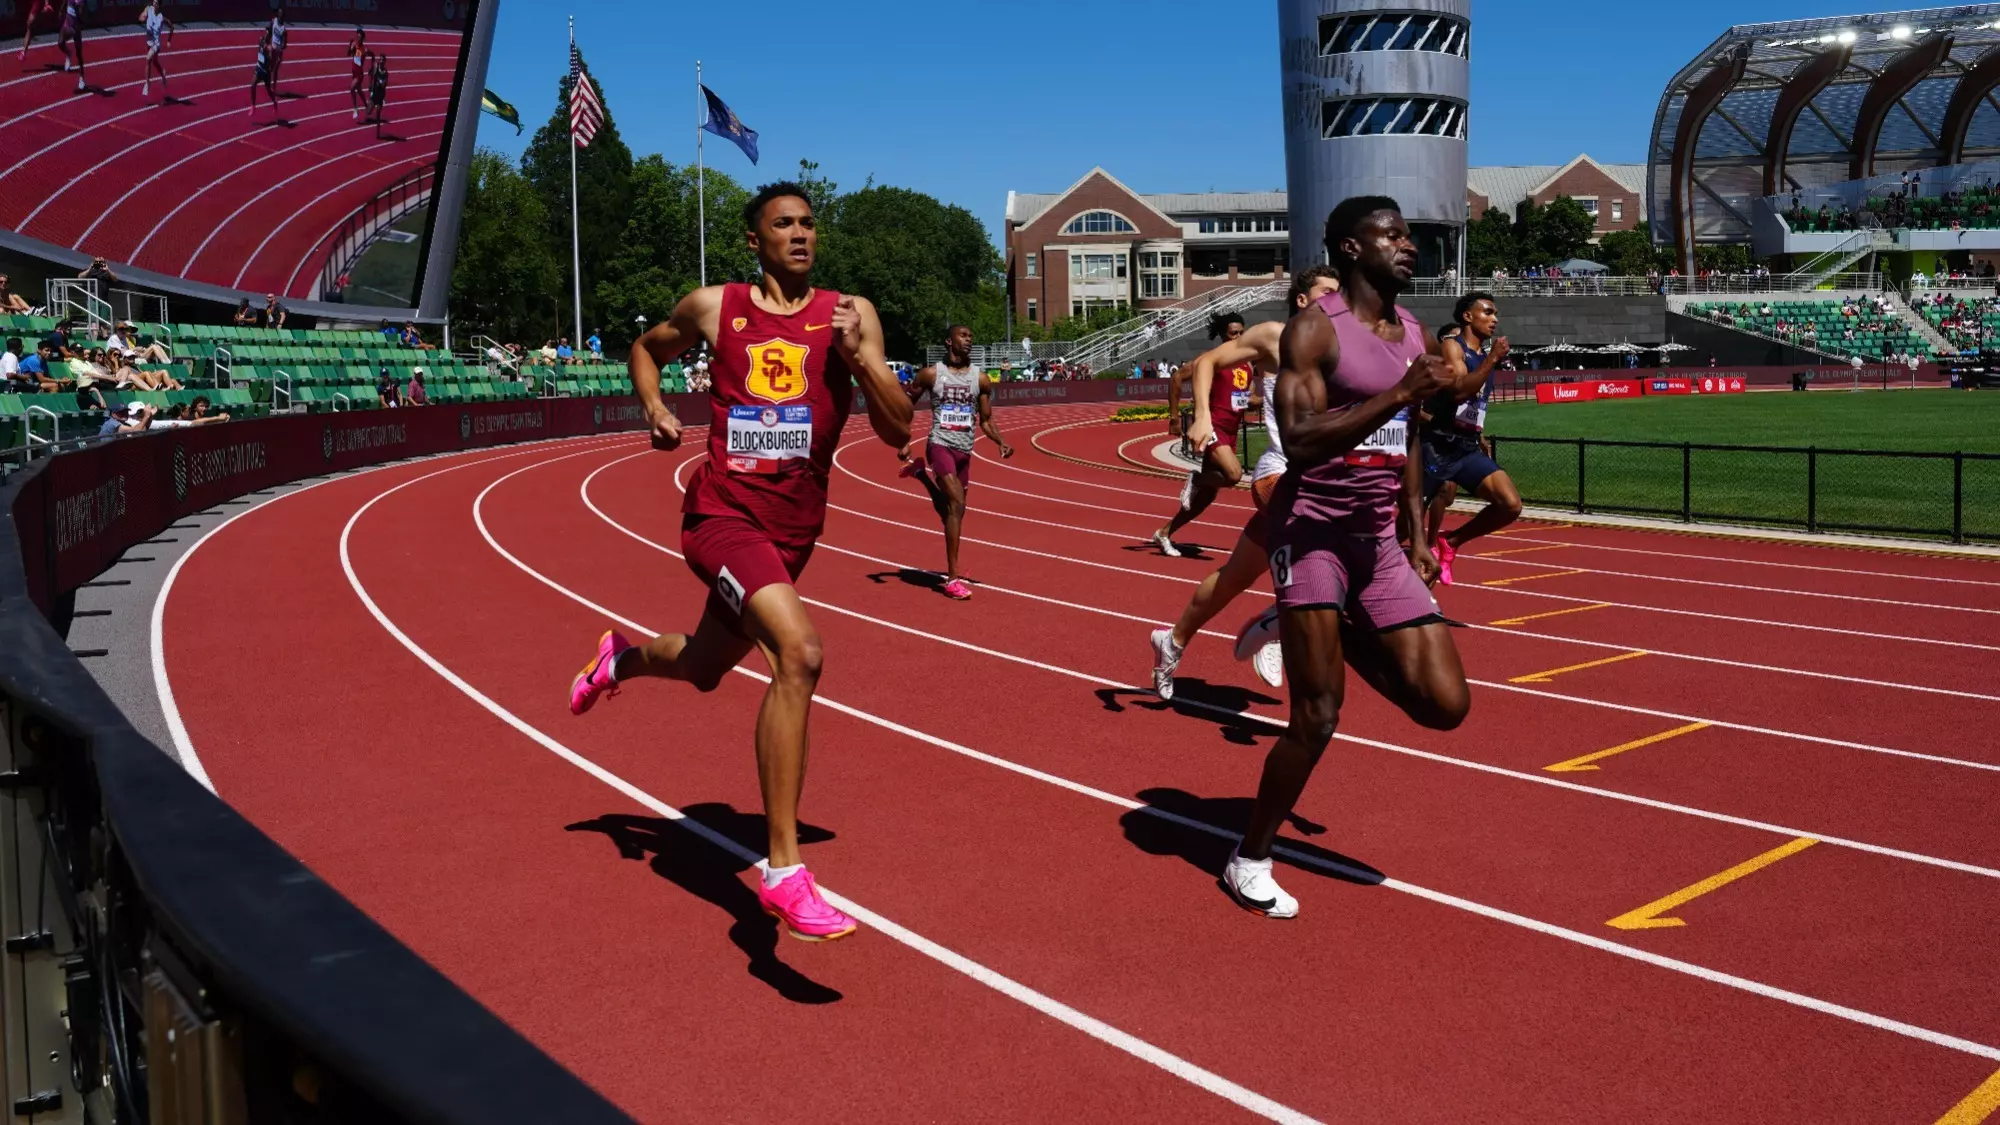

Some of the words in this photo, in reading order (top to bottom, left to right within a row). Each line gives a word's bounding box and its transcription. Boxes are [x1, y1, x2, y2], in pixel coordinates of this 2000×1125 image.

[732, 430, 808, 450] BLOCKBURGER
[1275, 549, 1288, 585] 8
[720, 576, 740, 608] 9
